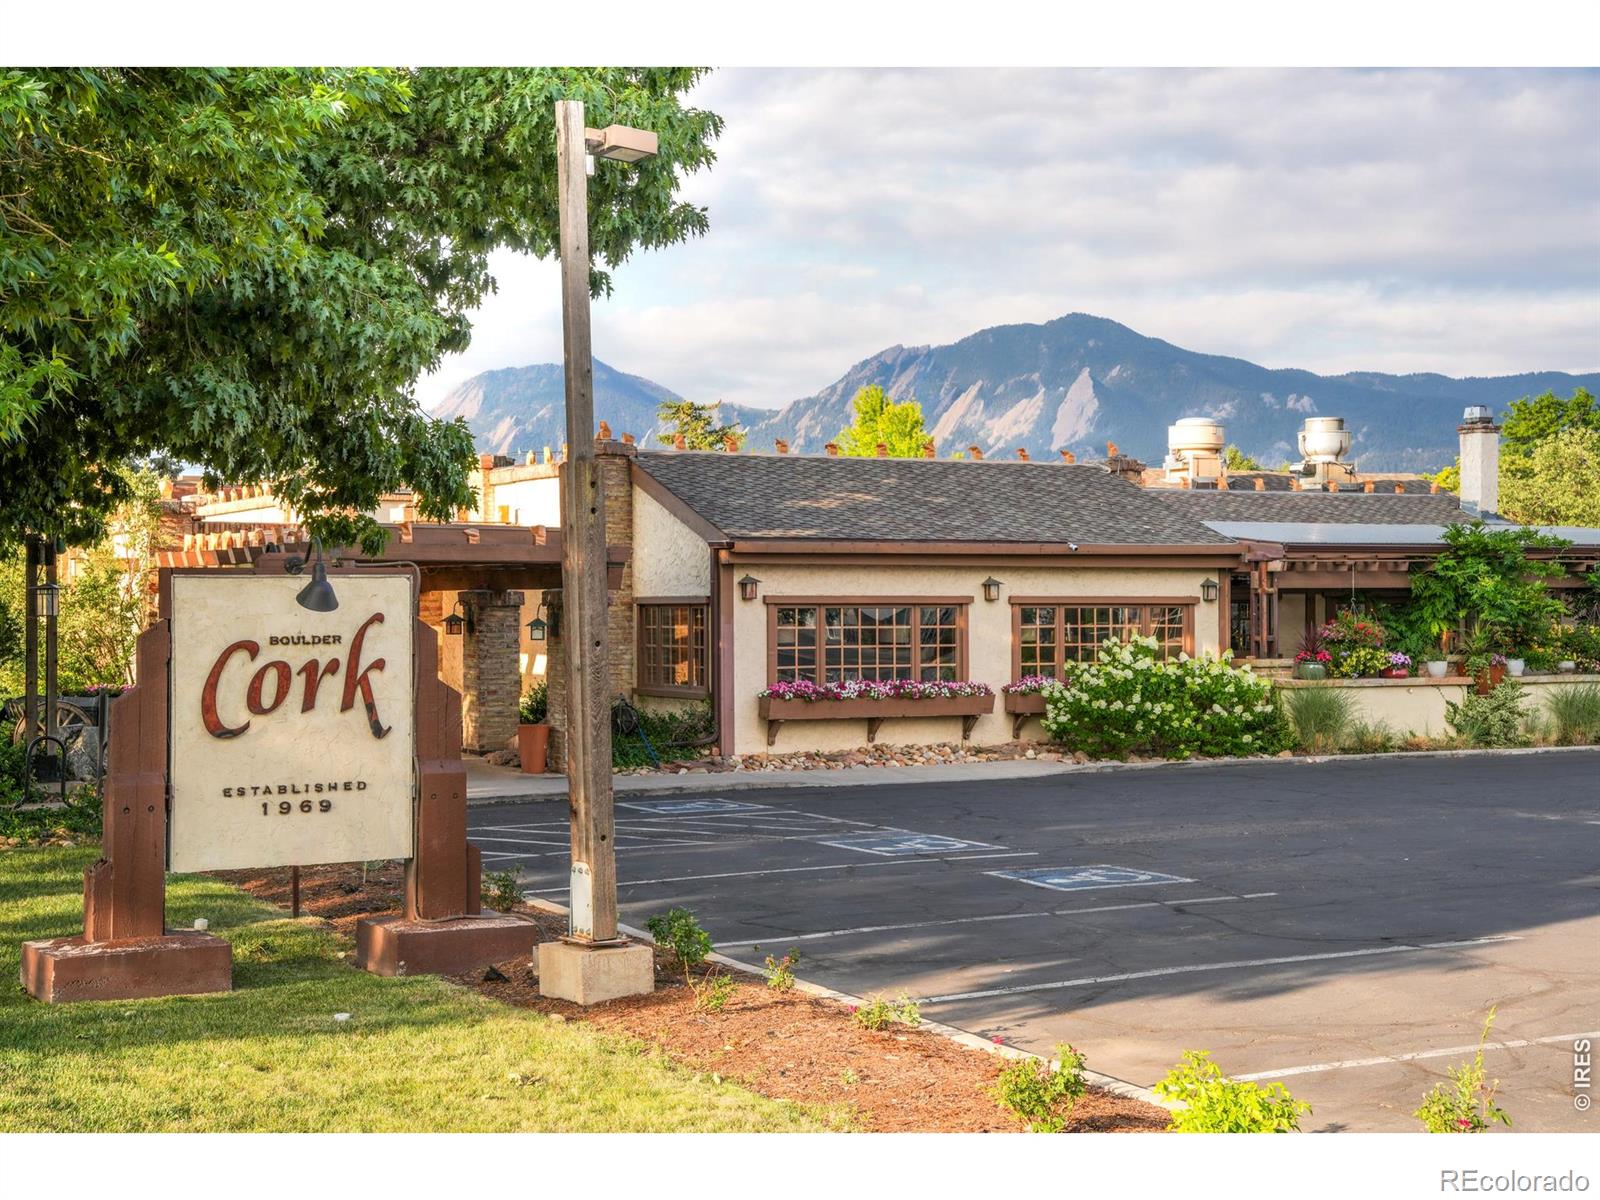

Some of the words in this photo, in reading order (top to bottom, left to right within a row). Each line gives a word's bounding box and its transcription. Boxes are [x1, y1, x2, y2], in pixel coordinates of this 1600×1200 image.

[269, 634, 342, 646] BOULDER
[201, 612, 392, 739] Cork
[223, 780, 368, 798] ESTABLISHED
[262, 799, 333, 816] 1969
